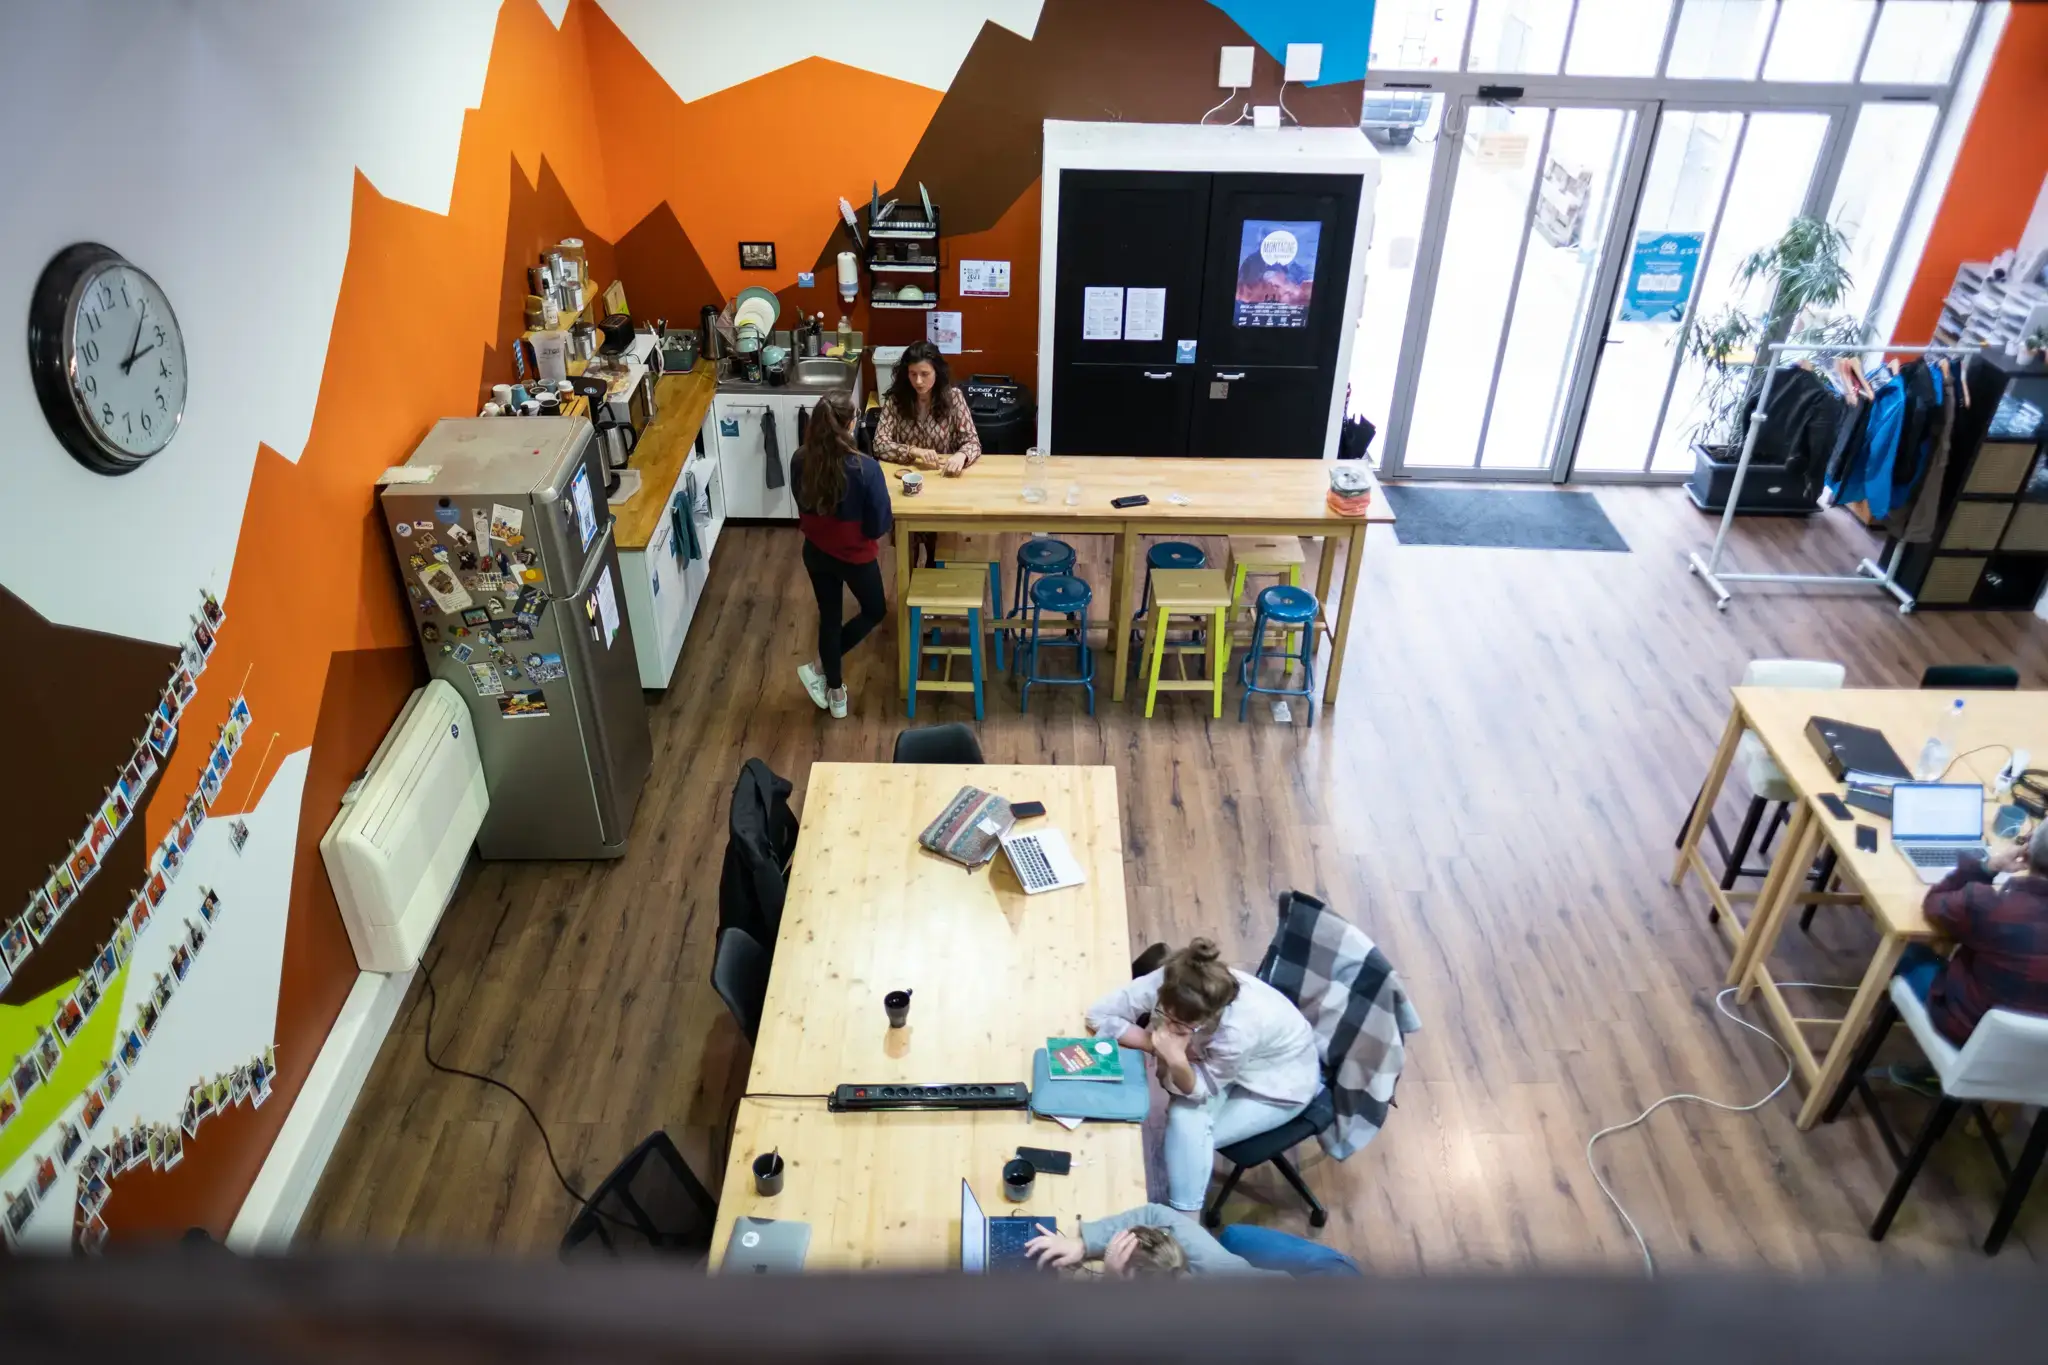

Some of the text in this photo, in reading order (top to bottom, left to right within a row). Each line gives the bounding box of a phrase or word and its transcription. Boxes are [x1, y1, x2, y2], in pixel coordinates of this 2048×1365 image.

[97, 288, 116, 312] 12
[120, 286, 130, 308] 1
[138, 298, 149, 320] 2
[85, 308, 102, 333] 11
[153, 325, 164, 347] 3
[80, 339, 99, 366] 10
[158, 358, 169, 378] 4
[85, 375, 97, 397] 9
[154, 387, 165, 409] 5
[102, 403, 114, 425] 8
[122, 412, 132, 434] 7
[140, 409, 152, 431] 6
